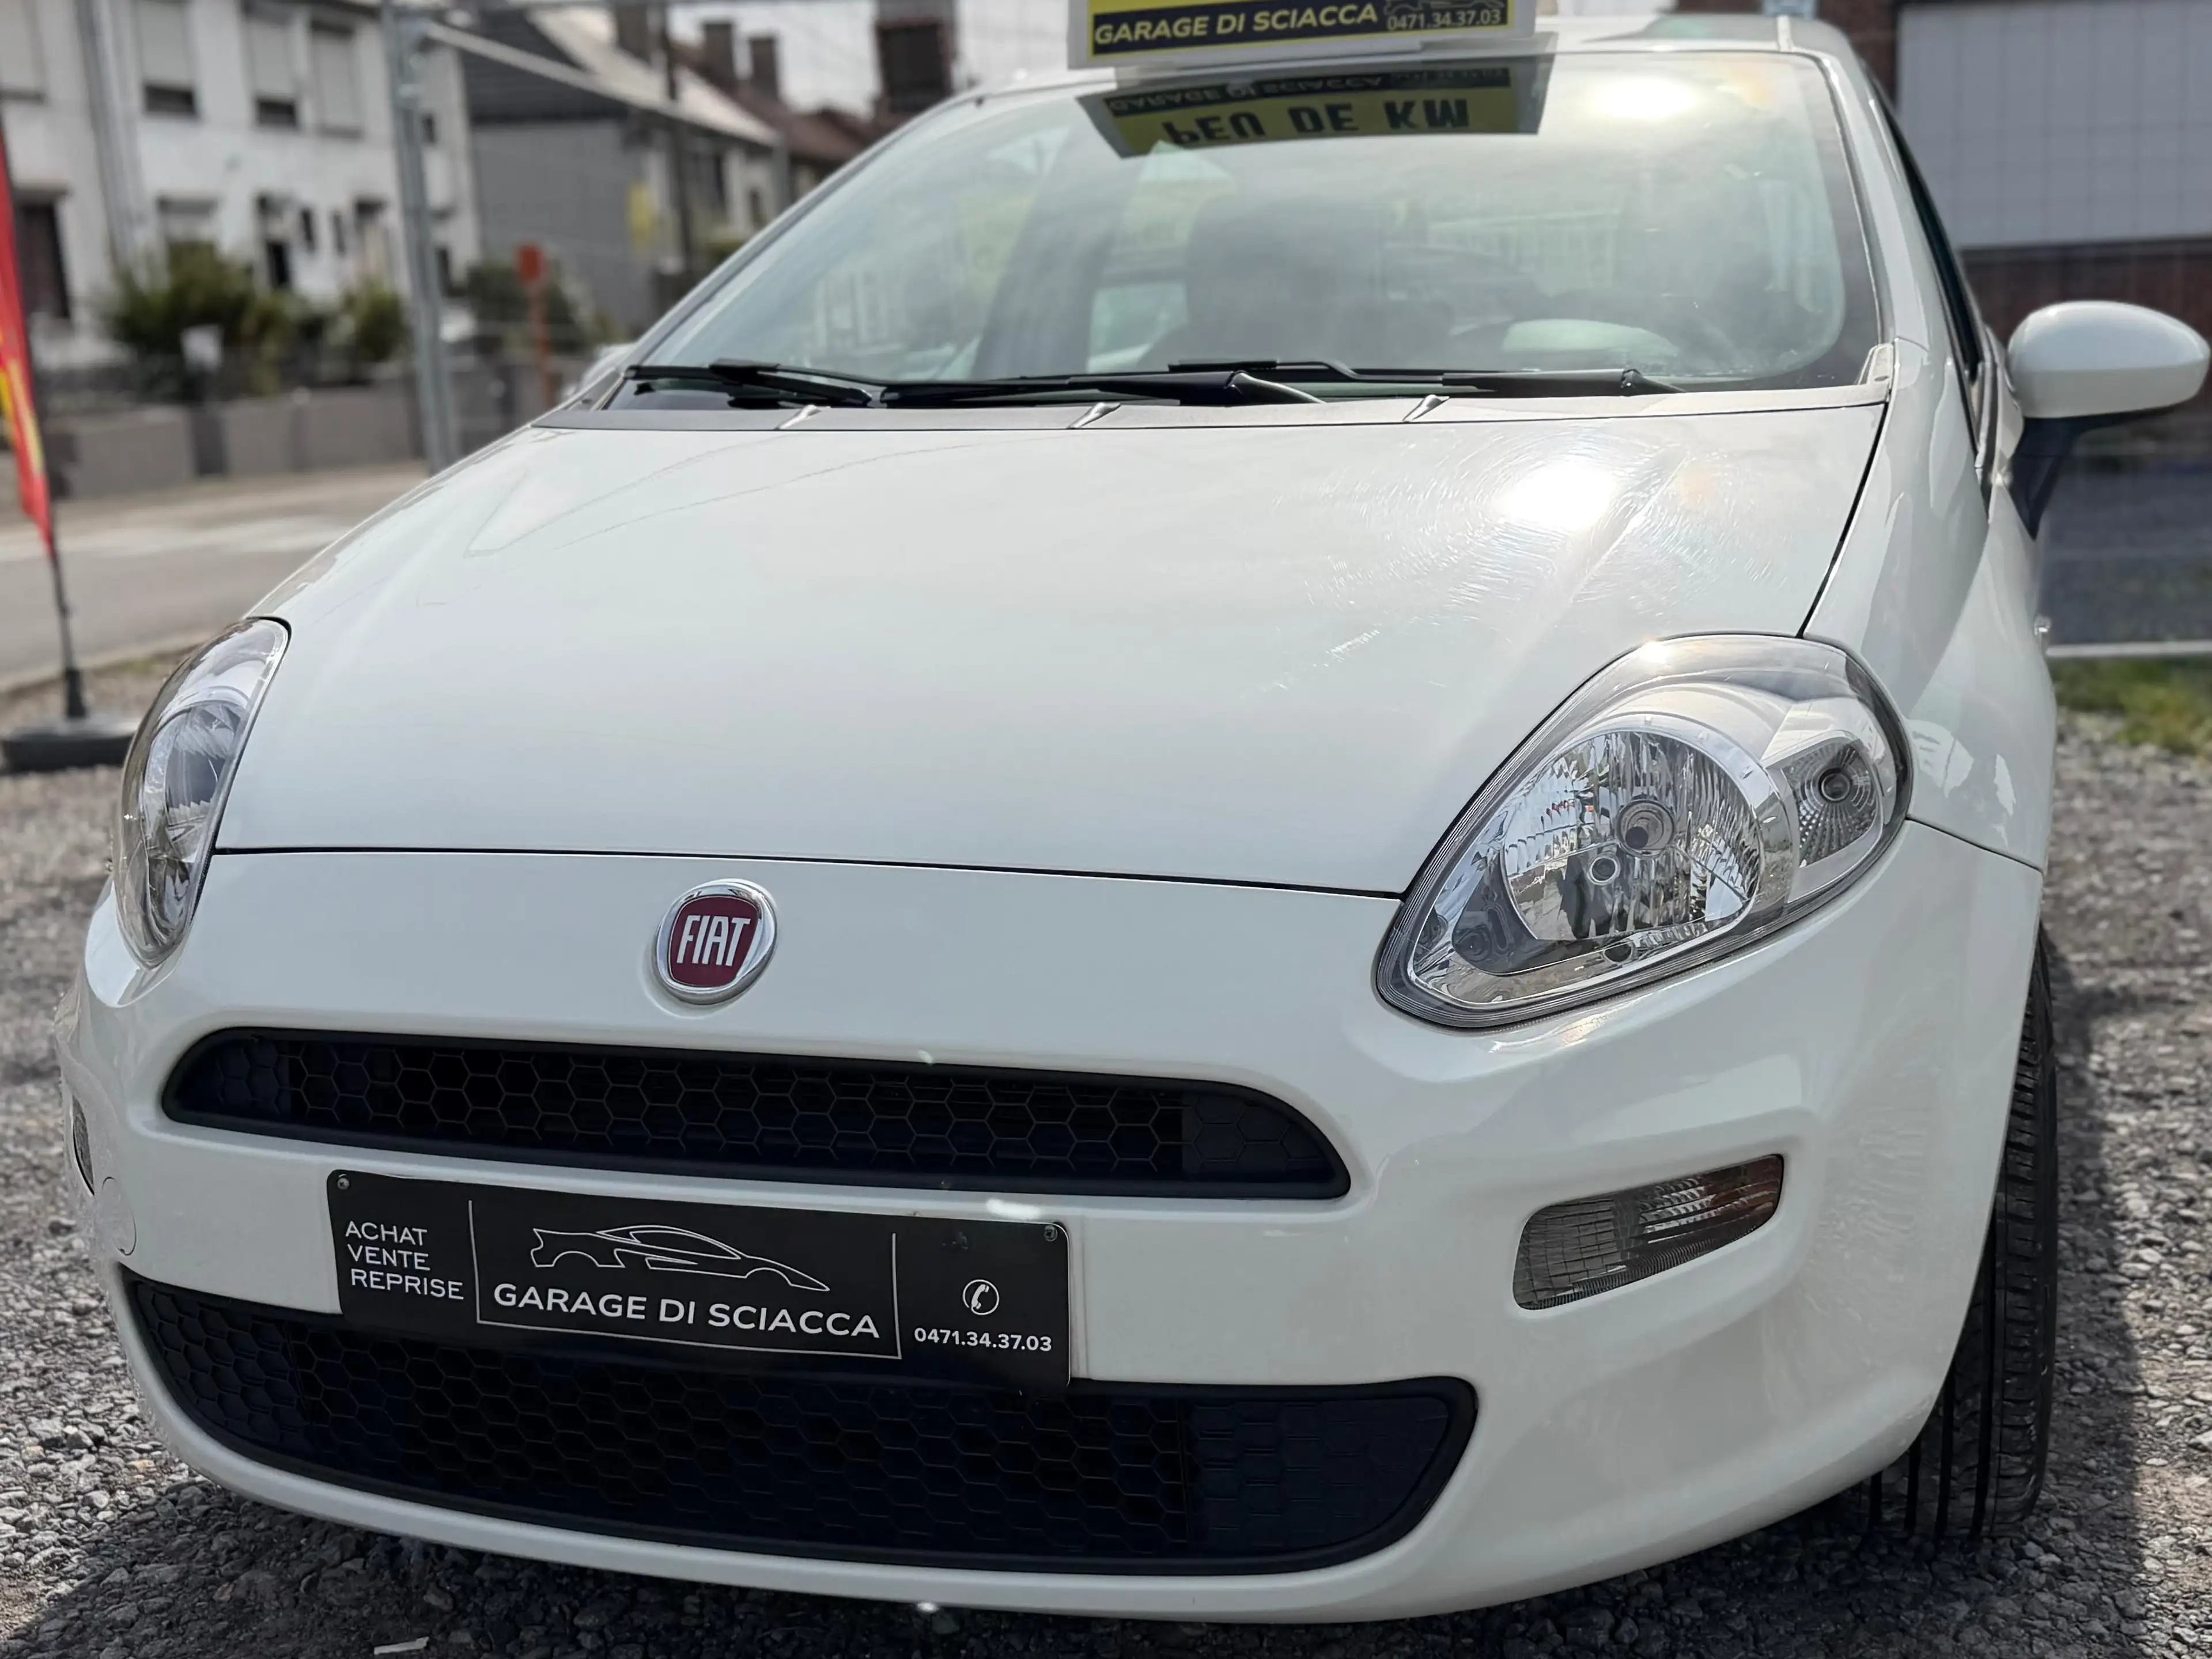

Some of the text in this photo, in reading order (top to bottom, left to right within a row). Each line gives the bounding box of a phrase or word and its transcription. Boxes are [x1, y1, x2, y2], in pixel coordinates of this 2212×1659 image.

[1095, 3, 1378, 45] GARAGE DI SCIACCA
[1387, 9, 1501, 31] 0471.34.37.03
[676, 915, 751, 967] FIAT
[345, 1220, 428, 1246] ACHAT
[347, 1243, 431, 1271] VENTE
[350, 1268, 464, 1300] REPRISE
[493, 1283, 880, 1339] GARAGE DI SCIACCA
[914, 1327, 1052, 1352] 0471.34.37.03
